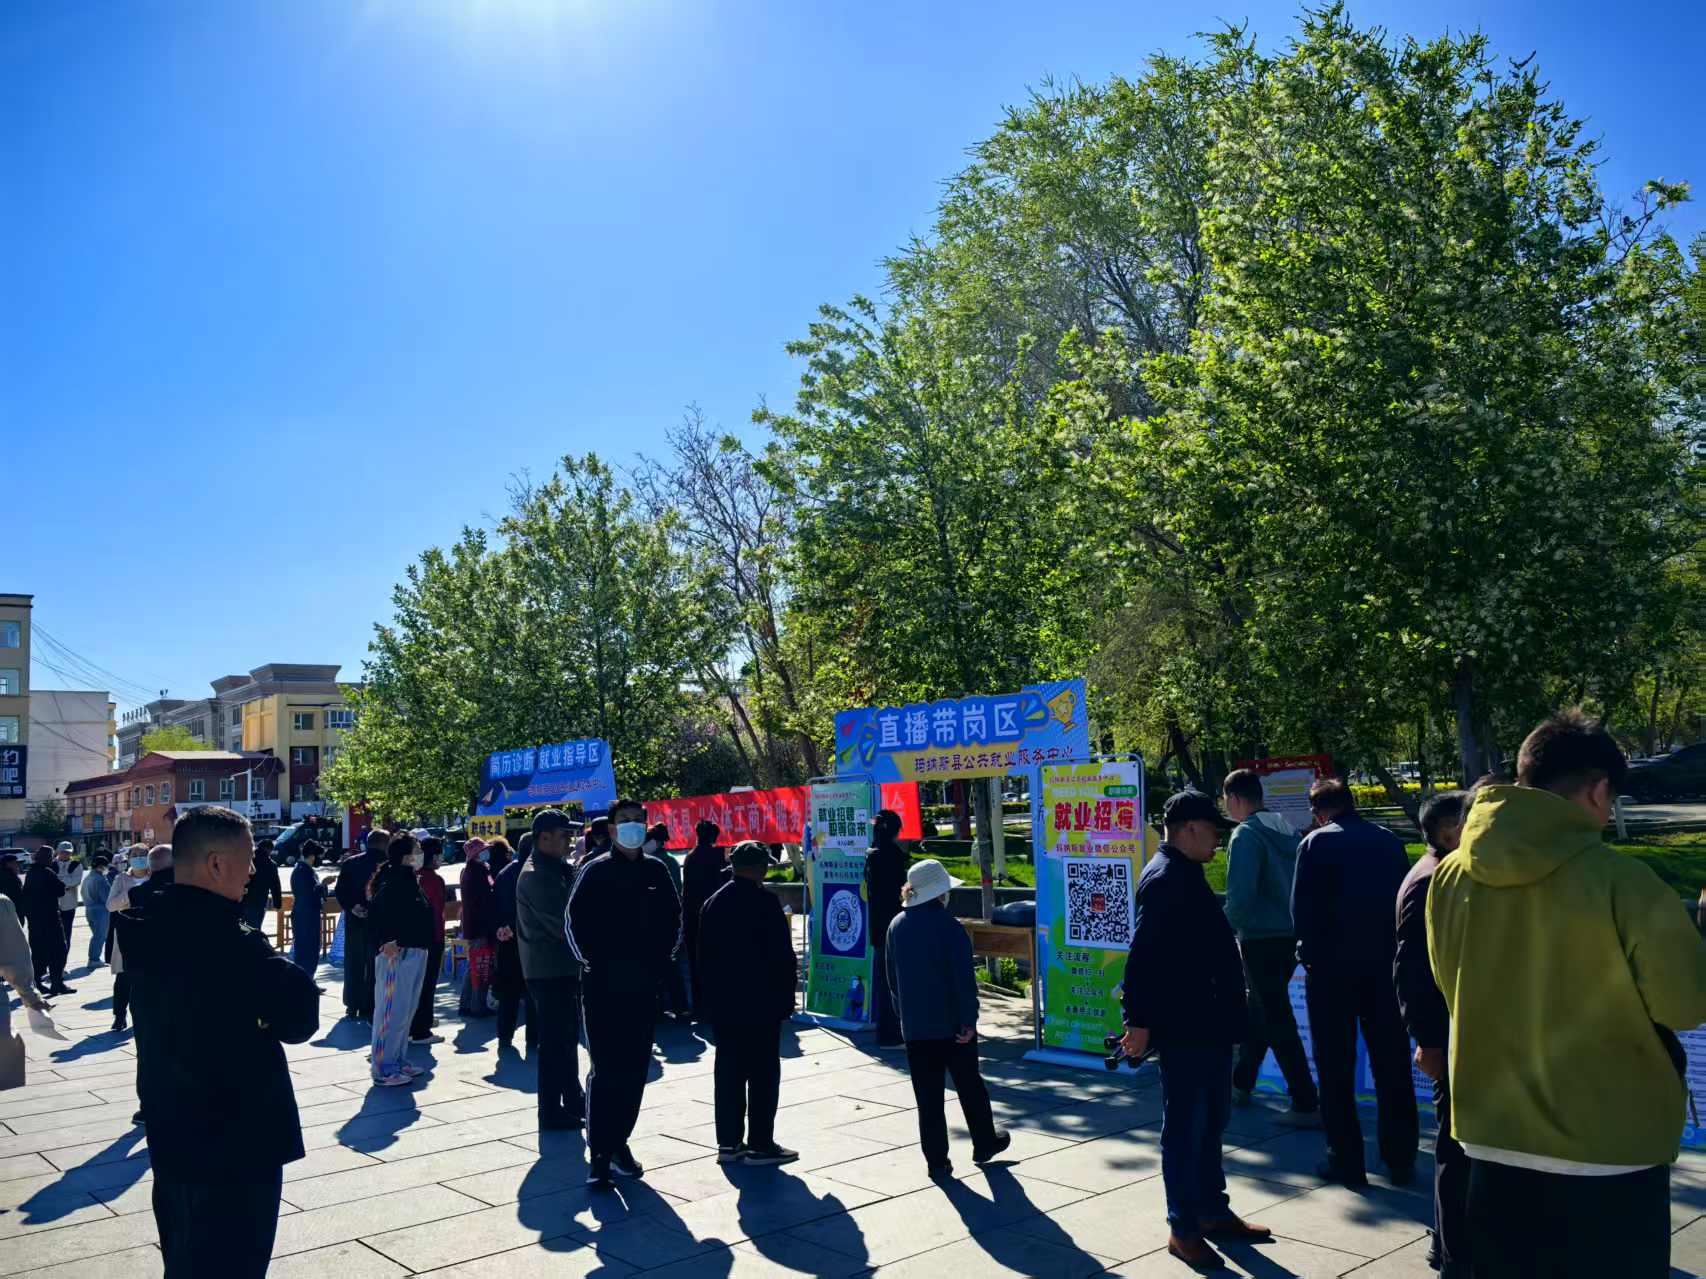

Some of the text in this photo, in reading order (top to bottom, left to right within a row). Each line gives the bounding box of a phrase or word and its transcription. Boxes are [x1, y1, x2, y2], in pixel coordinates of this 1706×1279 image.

[879, 702, 1019, 748] 直播带岗区
[490, 742, 601, 776] 简历诊断 就业指导区
[1054, 800, 1134, 832] 就业招聘
